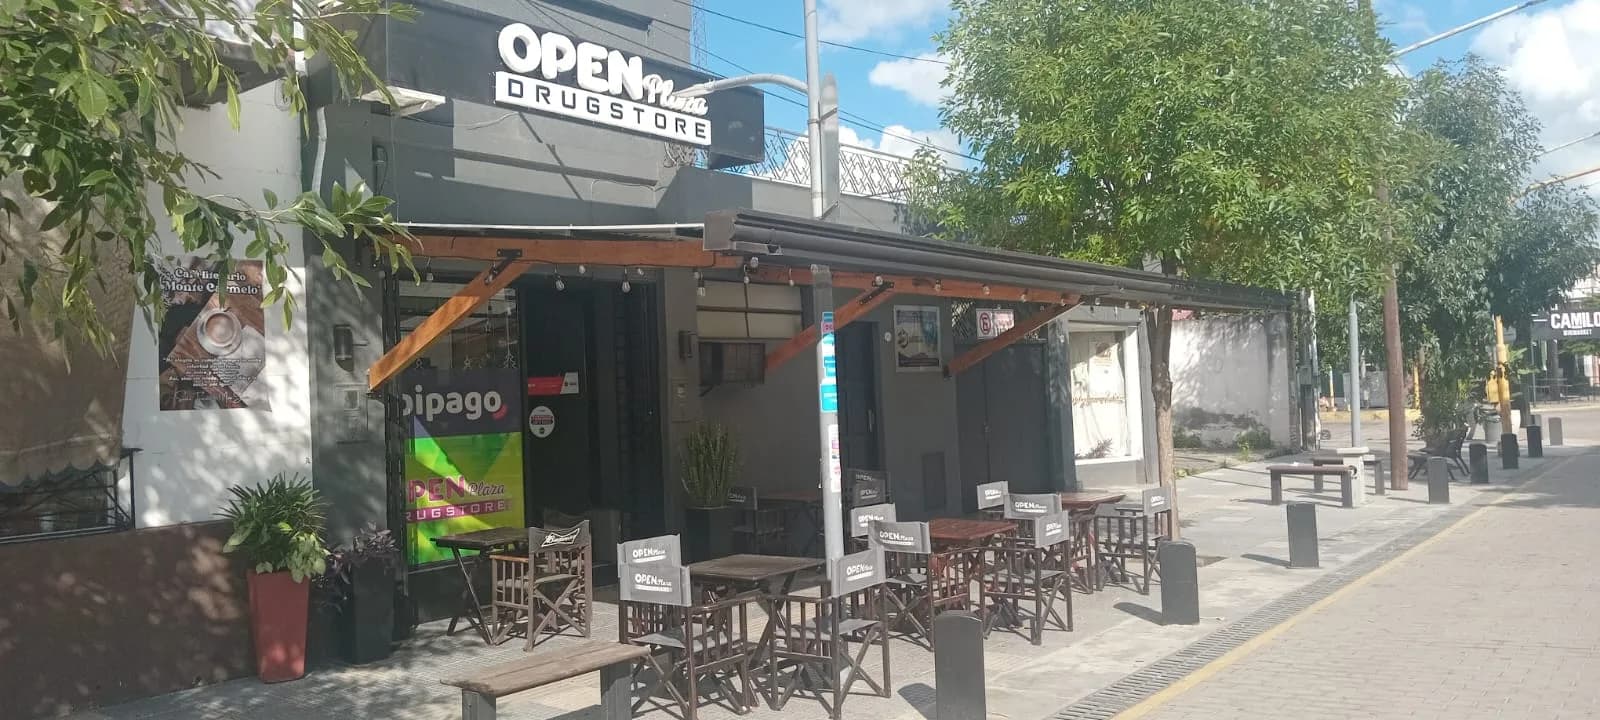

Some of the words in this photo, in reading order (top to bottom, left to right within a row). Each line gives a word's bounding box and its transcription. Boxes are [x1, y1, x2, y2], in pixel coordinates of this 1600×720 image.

[497, 22, 643, 100] OPEN
[508, 78, 706, 139] DRUGSTORE
[468, 479, 505, 497] Plaza
[632, 547, 653, 559] OPEN
[846, 563, 865, 576] OPEN
[635, 573, 657, 585] OPEN
